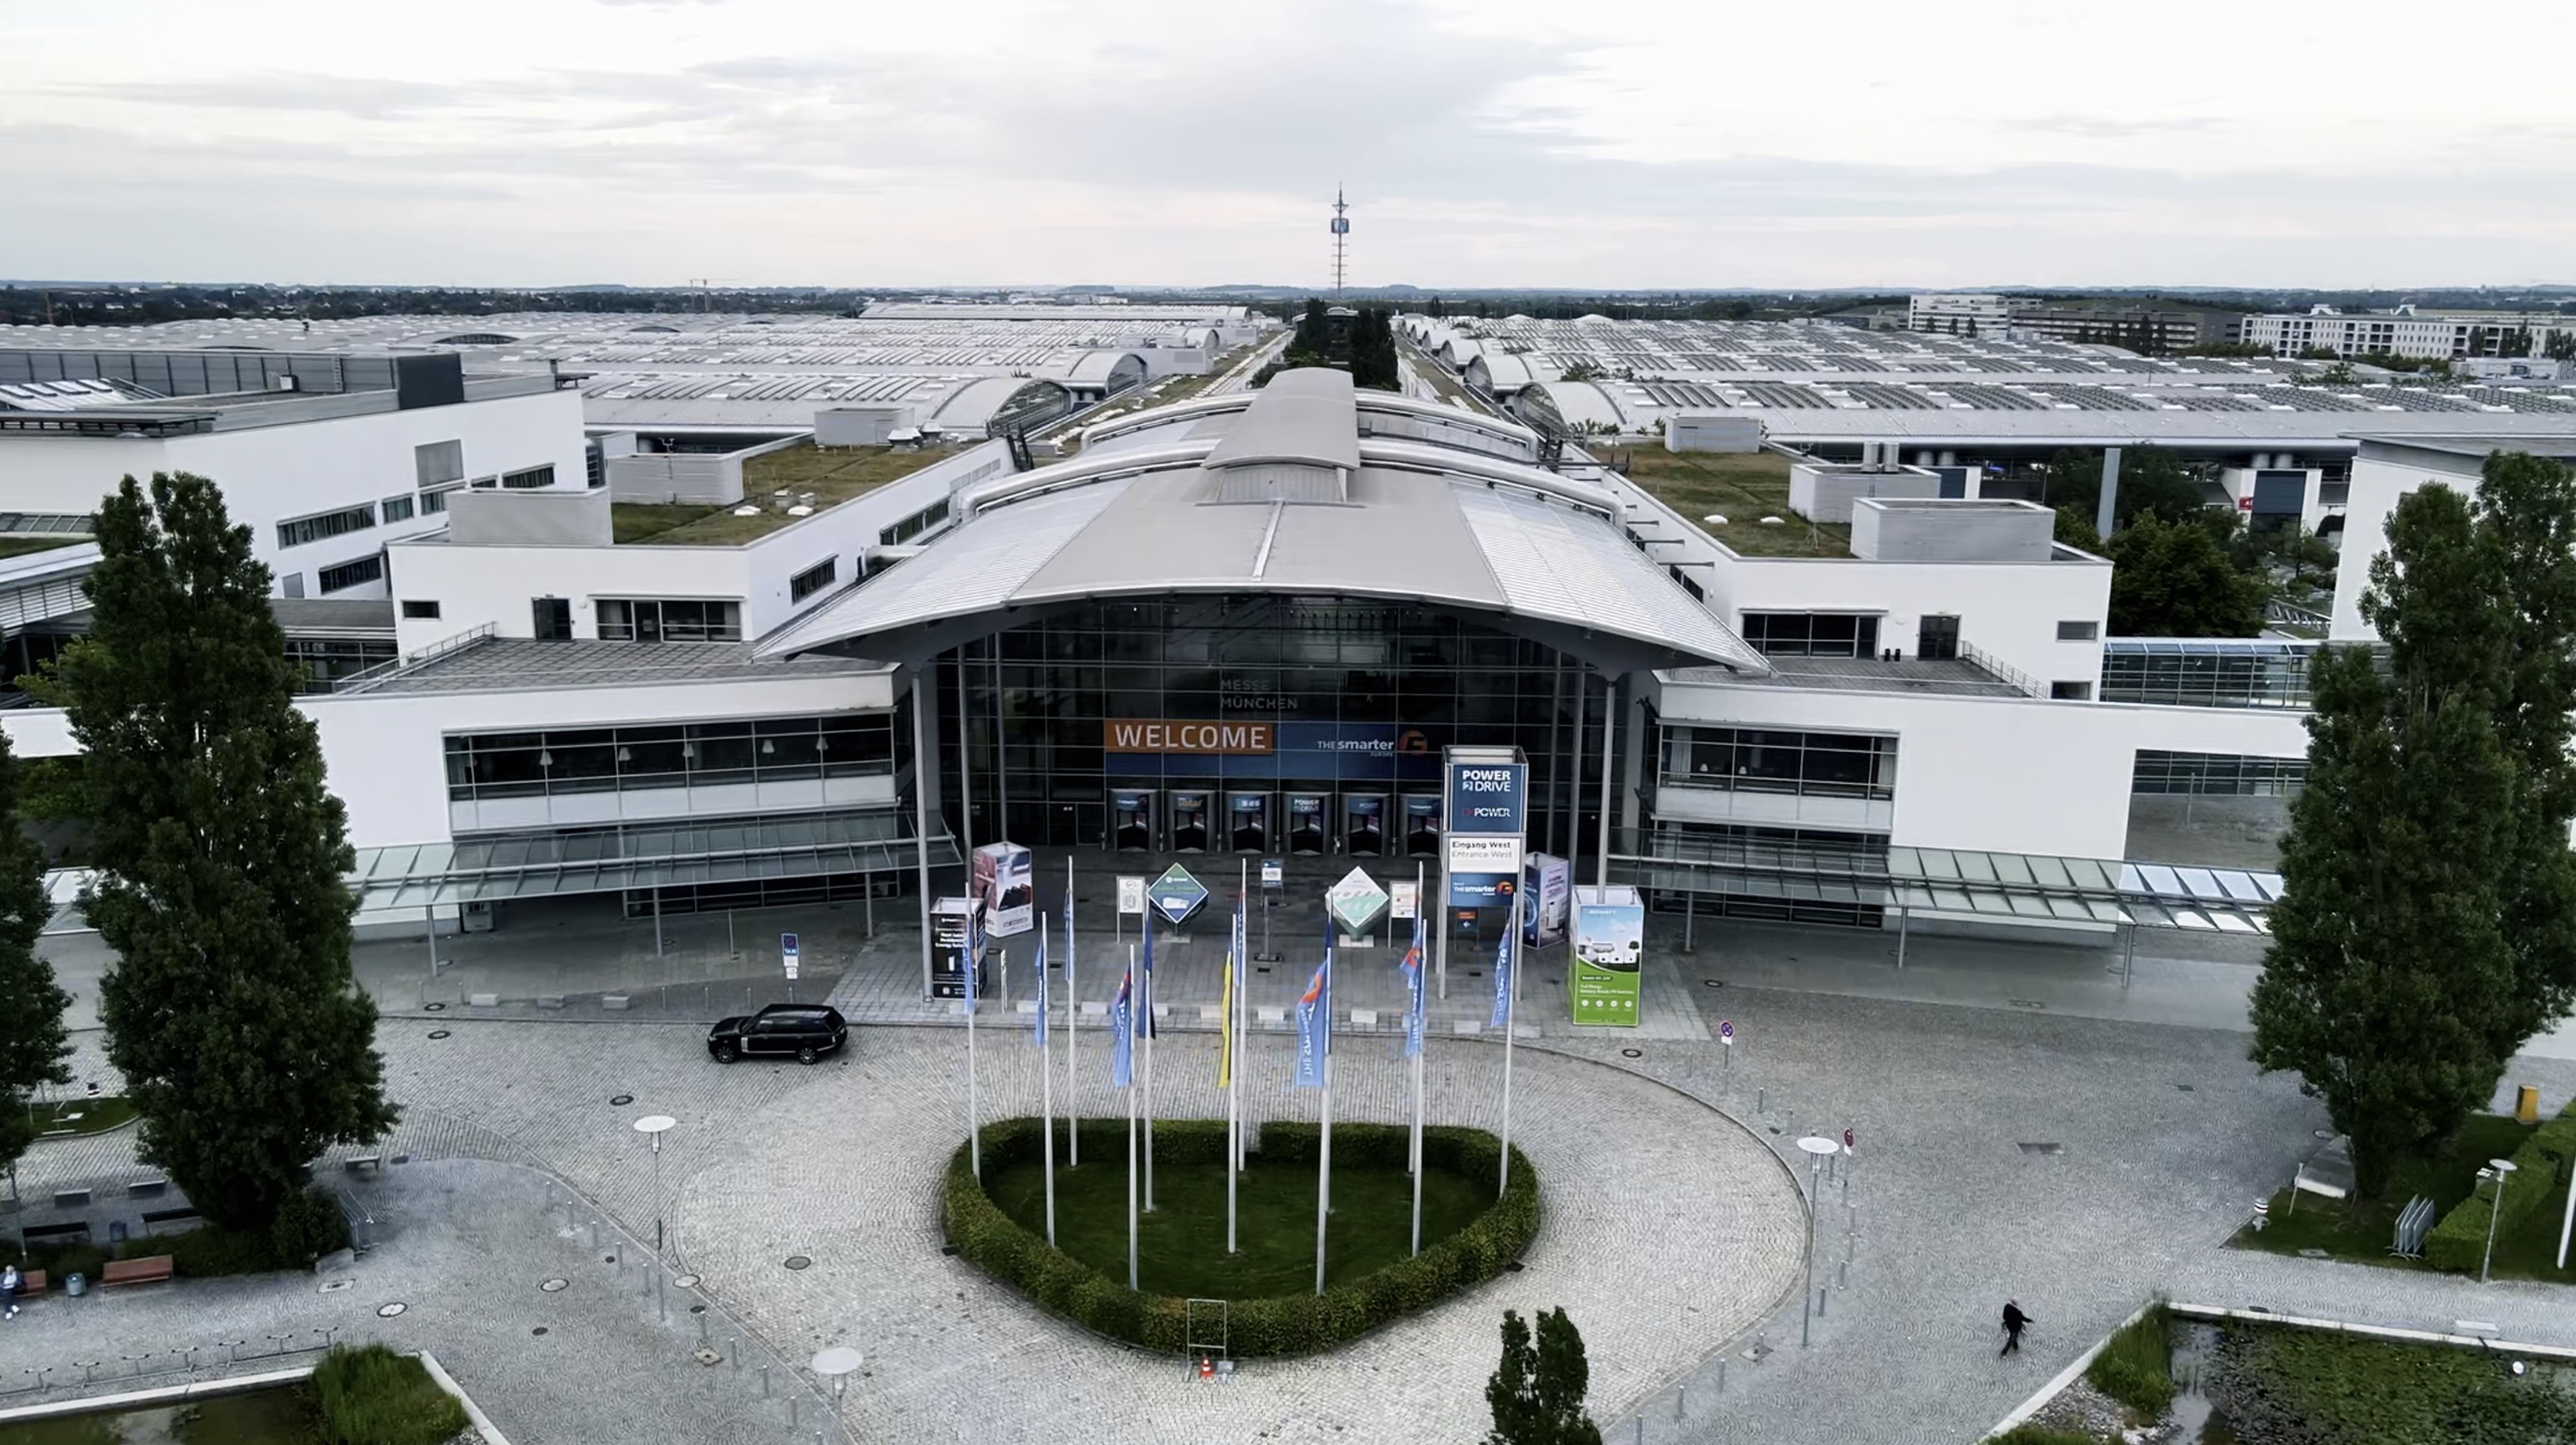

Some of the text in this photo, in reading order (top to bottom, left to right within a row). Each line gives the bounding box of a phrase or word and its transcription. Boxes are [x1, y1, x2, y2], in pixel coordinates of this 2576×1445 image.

[1221, 680, 1270, 691] MESSE
[1221, 696, 1298, 709] MÜNCHEN
[1115, 724, 1266, 749] WELCOME
[1337, 739, 1394, 750] smarter
[1462, 769, 1511, 782] POWER
[1452, 841, 1486, 850] Eingang
[1452, 850, 1512, 859] Entrance West
